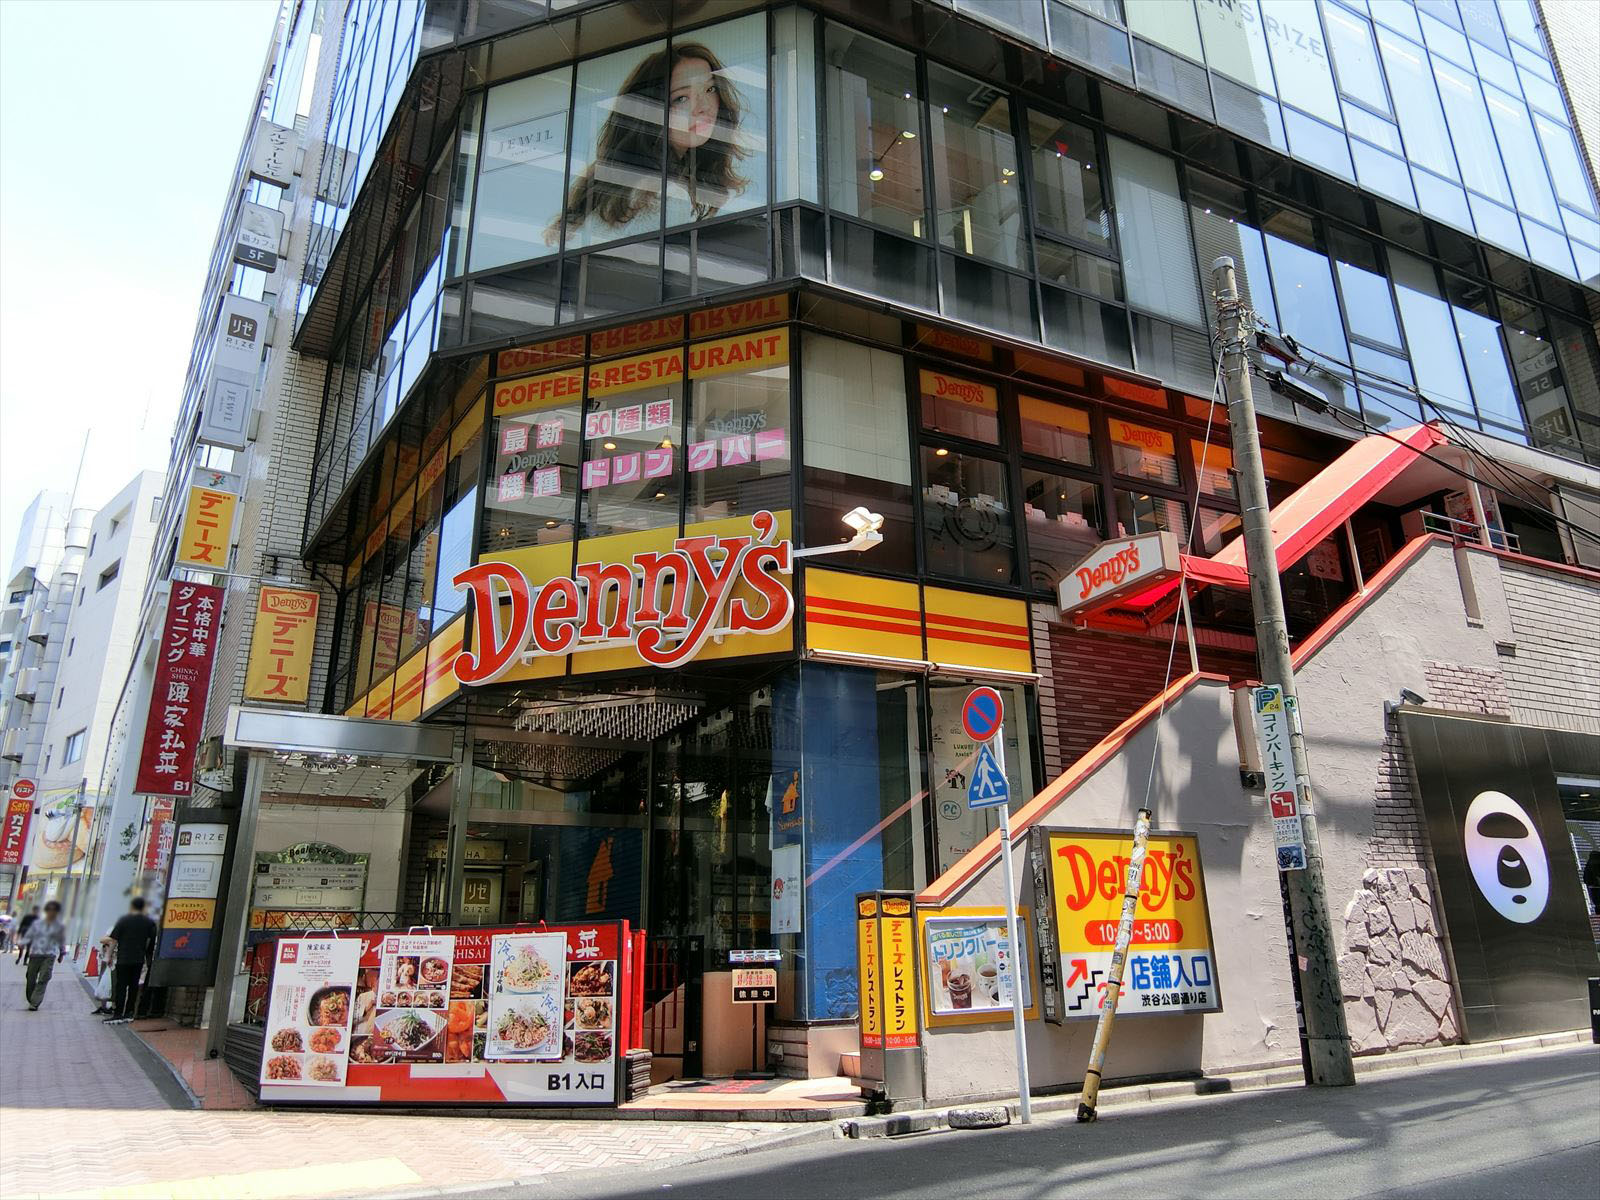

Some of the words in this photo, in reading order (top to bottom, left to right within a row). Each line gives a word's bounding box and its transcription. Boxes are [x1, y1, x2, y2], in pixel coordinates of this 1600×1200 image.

[1265, 14, 1324, 58] RIZE
[248, 249, 265, 261] 5F
[232, 318, 254, 338] リゼ
[496, 372, 581, 408] COFFEE
[604, 335, 782, 388] RESTAURANT
[935, 374, 984, 403] Denny's
[713, 409, 767, 436] Denny's
[1122, 422, 1163, 448] Denny's
[505, 421, 561, 451] 最新
[509, 448, 559, 474] Denny's
[586, 433, 782, 487] ドリンクバー
[501, 471, 559, 497] 機種
[189, 491, 231, 563] デニーズ
[1075, 543, 1140, 599] Denny's
[271, 592, 309, 610] Denny's
[452, 510, 794, 686] Denny's
[167, 586, 196, 663] ダイニング
[188, 596, 215, 658] 本格中華
[263, 615, 308, 698] デニーズ
[169, 666, 199, 676] CHINKA
[171, 673, 197, 682] SHISAI
[154, 681, 190, 774] 陳家私菜
[1262, 714, 1286, 792] コインパーキング
[173, 780, 190, 791] B1
[7, 814, 25, 849] ガスト
[195, 833, 225, 841] RIZE
[469, 882, 488, 900] リゼ
[168, 908, 209, 924] Denny's
[463, 906, 490, 914] RIZE
[454, 935, 490, 946] HINKA
[933, 937, 997, 963] ドリンクバー
[452, 949, 486, 959] HISAI
[1131, 955, 1212, 990] 店舗入口
[1141, 991, 1208, 1007] 渋谷公園通り店
